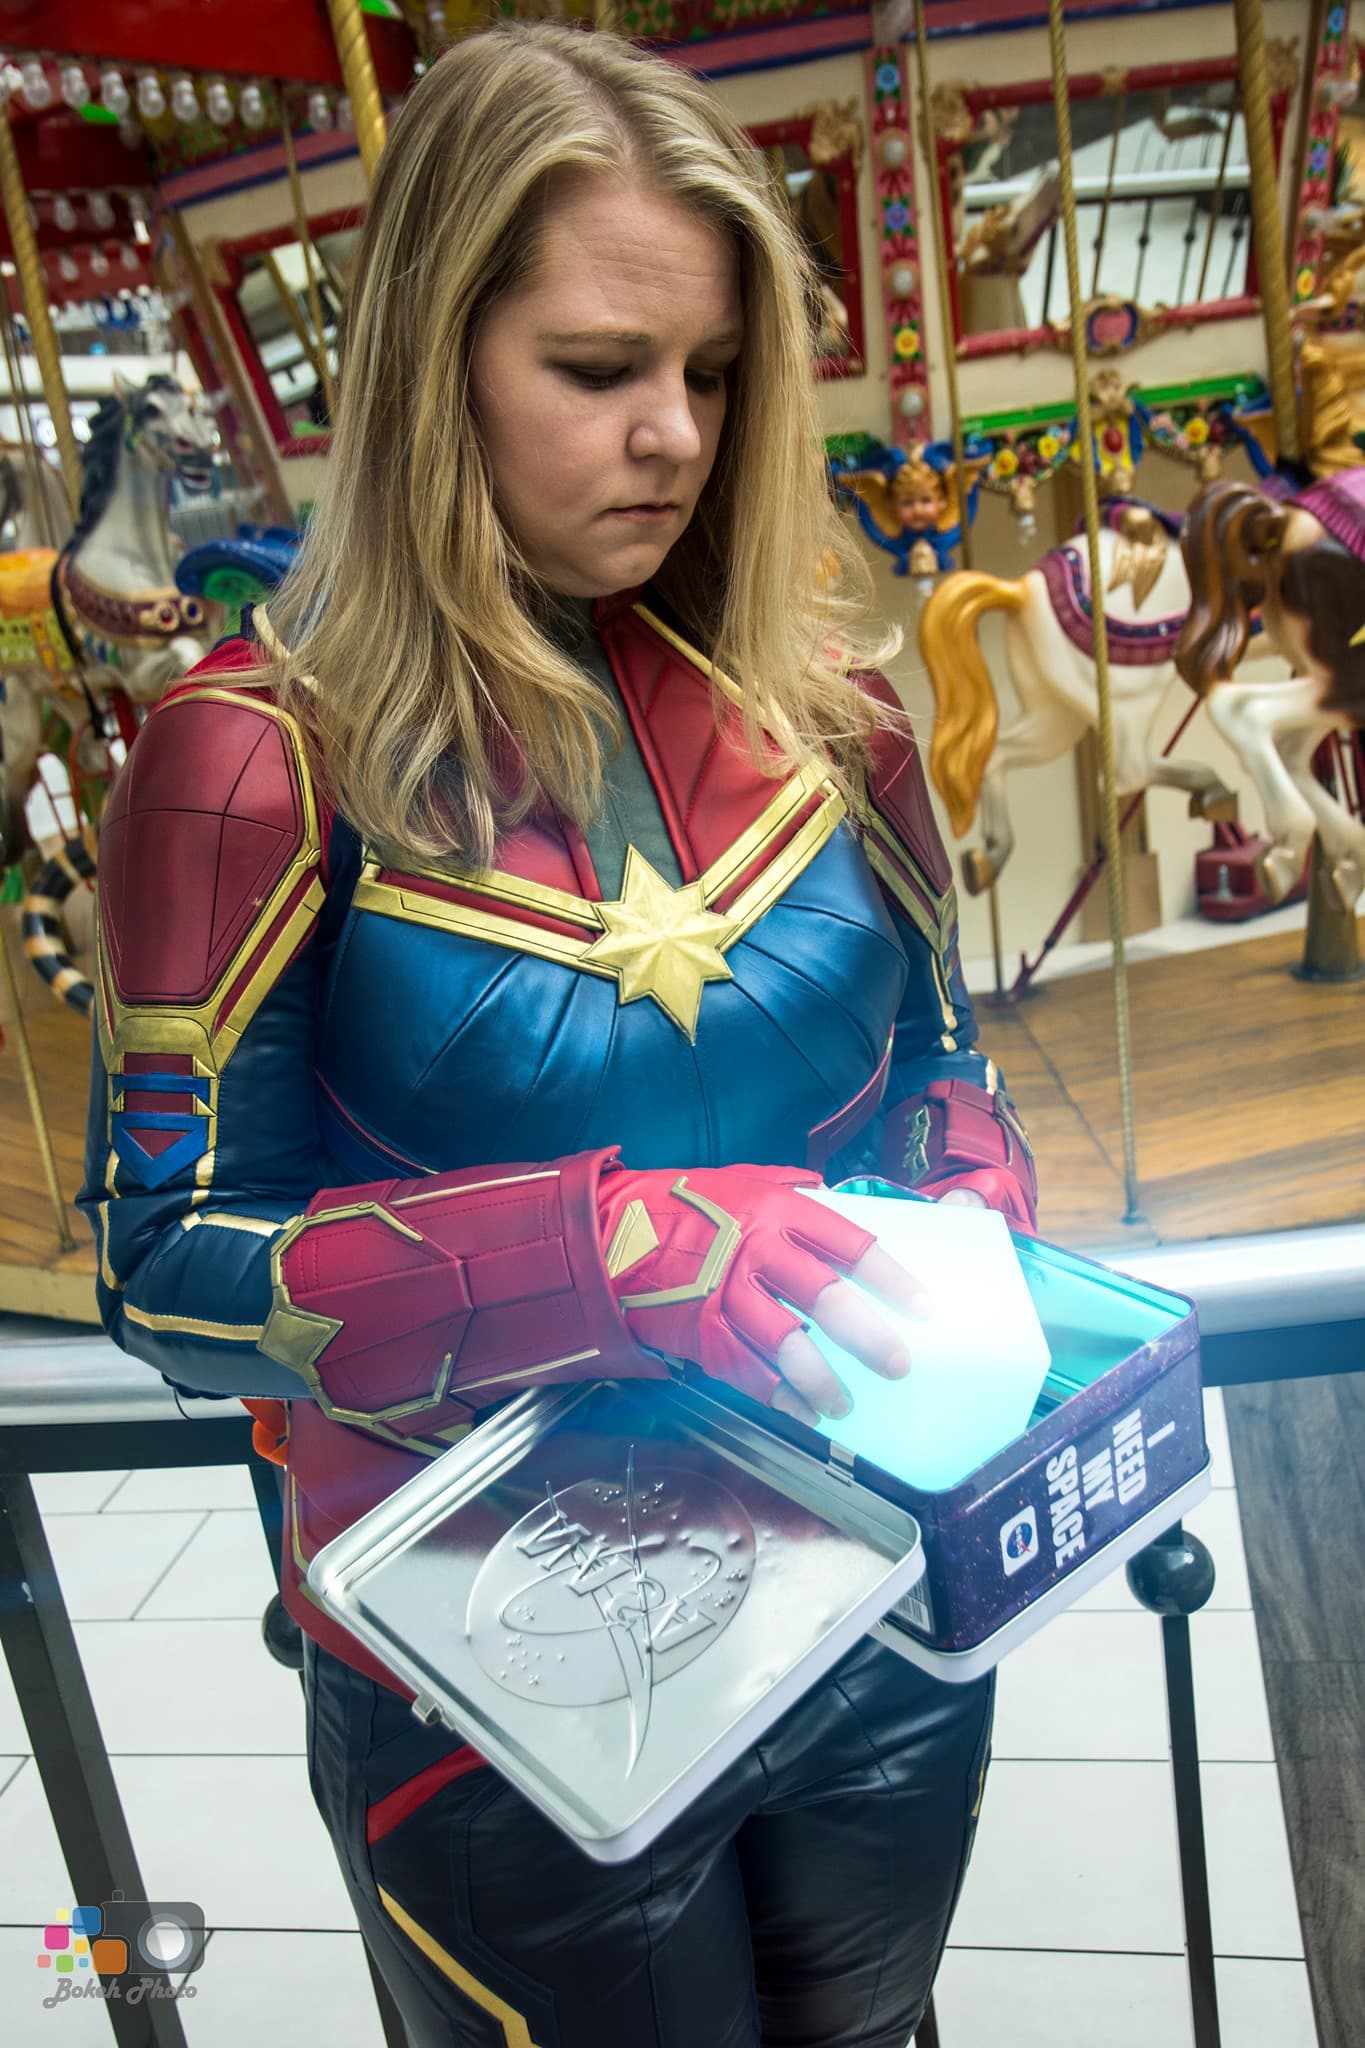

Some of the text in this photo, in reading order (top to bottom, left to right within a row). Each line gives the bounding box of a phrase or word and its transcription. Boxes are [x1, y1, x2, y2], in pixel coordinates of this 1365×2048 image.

[1112, 1408, 1146, 1505] NEED
[1147, 1421, 1175, 1449] I
[1046, 1445, 1086, 1569] SPACE
[1082, 1447, 1115, 1511] MY
